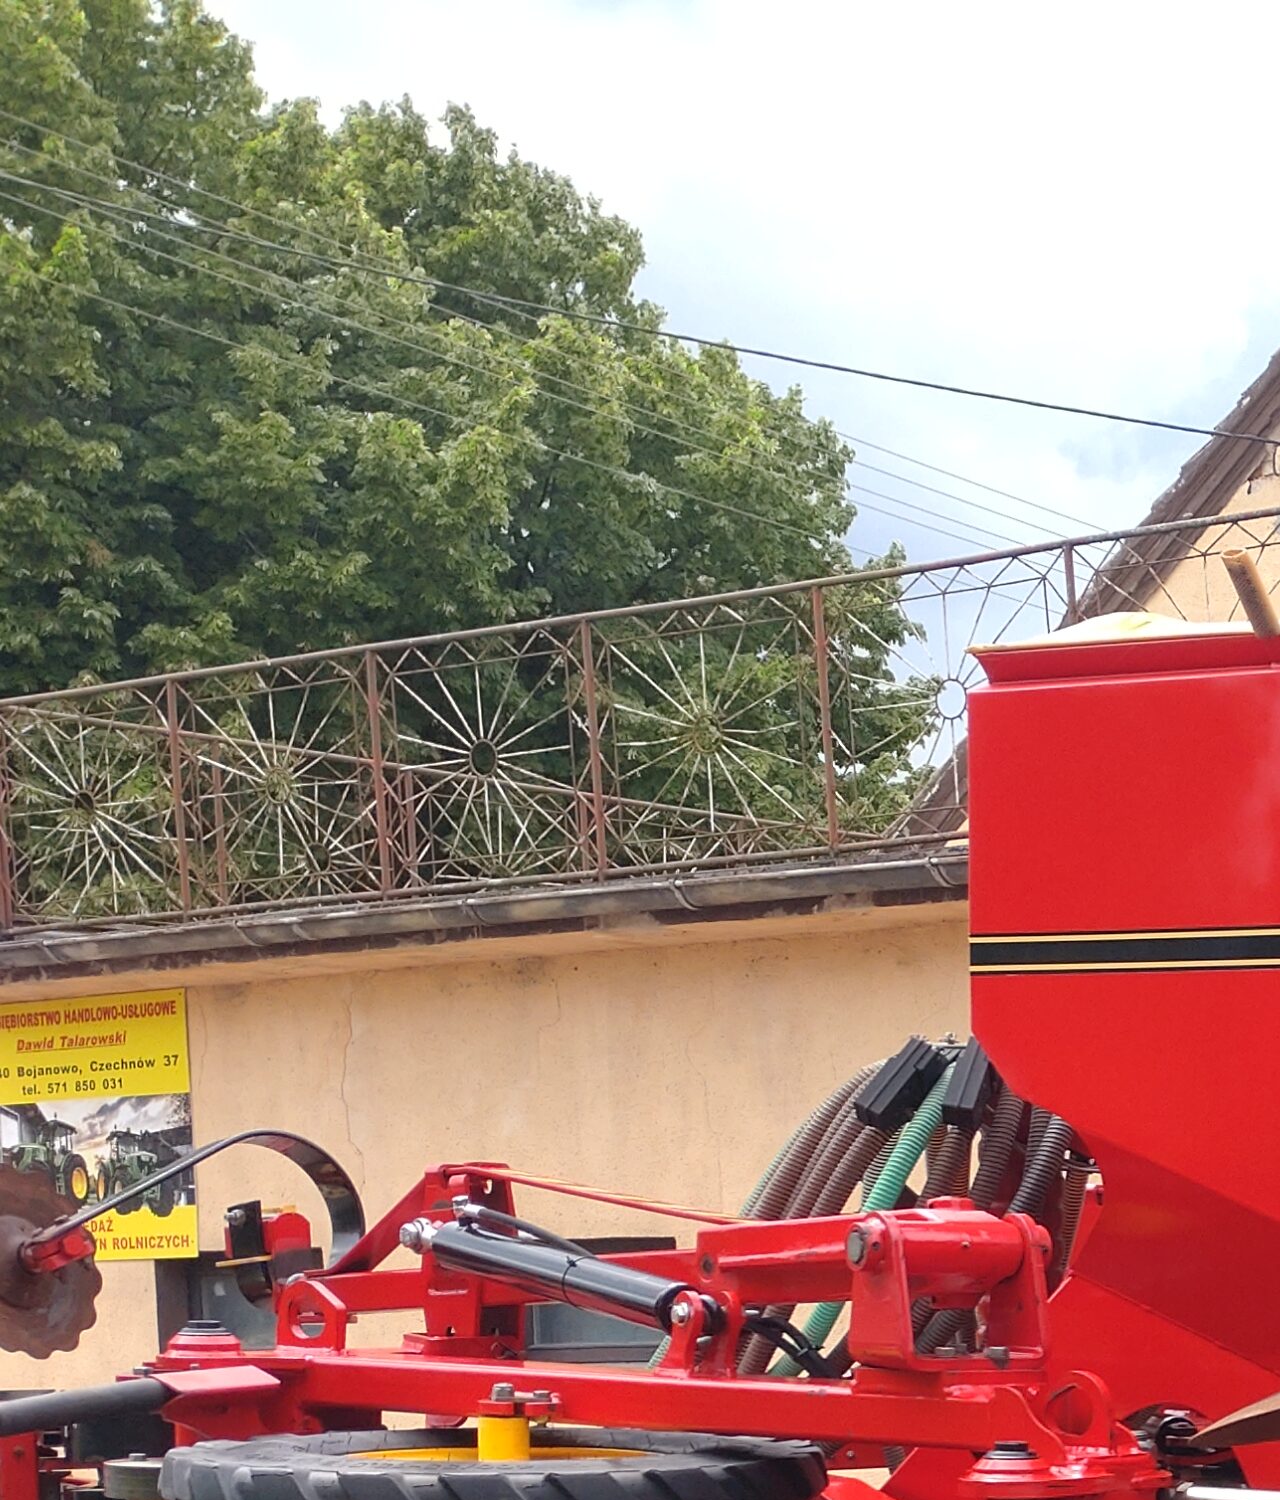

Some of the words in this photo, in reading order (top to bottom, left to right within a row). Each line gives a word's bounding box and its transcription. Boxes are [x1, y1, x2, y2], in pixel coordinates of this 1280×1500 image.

[0, 1011, 61, 1032] IĘBIORSTWO
[64, 1000, 177, 1025] HANDLOWO-USŁUGOWE
[17, 1036, 55, 1051] Dawid
[60, 1031, 127, 1048] Talarowski
[17, 1065, 83, 1079] Bojanowo,
[90, 1057, 156, 1072] Czechnów
[163, 1054, 179, 1067] 37
[22, 1084, 41, 1096] tel.
[47, 1081, 67, 1094] 571
[75, 1079, 96, 1092] 850
[102, 1077, 123, 1090] 031
[113, 1234, 190, 1251] ROLNICZYCH
